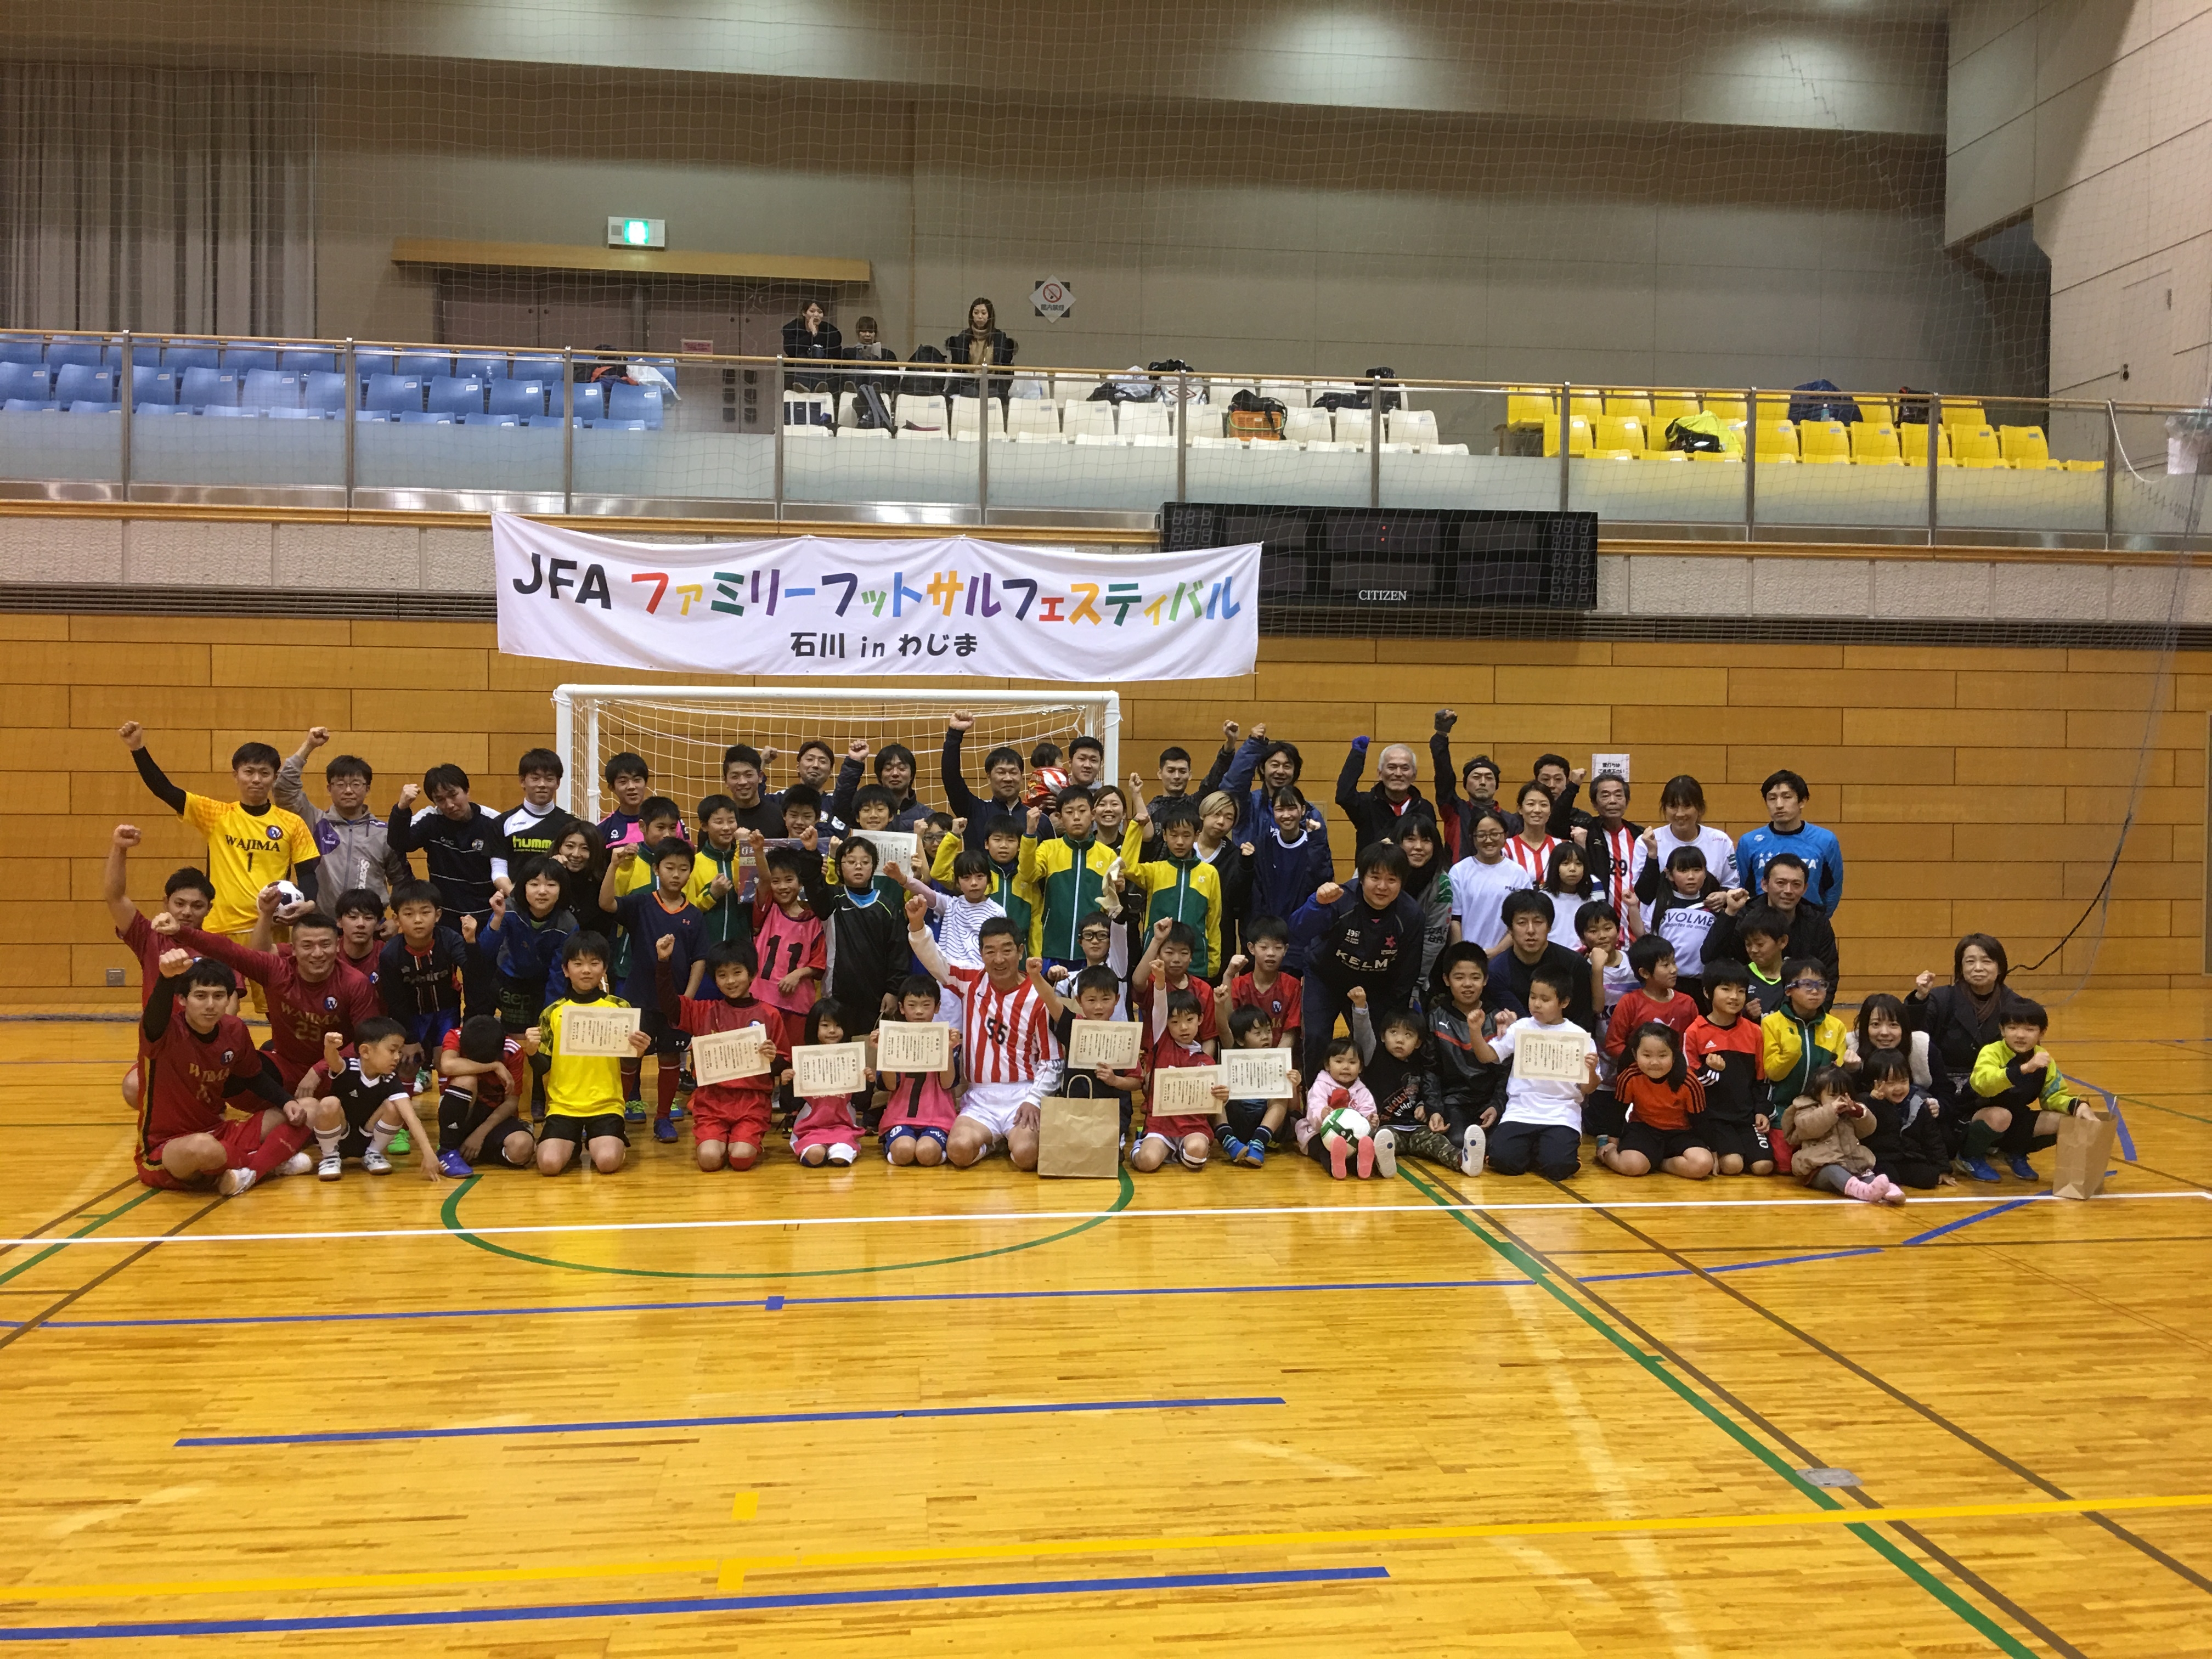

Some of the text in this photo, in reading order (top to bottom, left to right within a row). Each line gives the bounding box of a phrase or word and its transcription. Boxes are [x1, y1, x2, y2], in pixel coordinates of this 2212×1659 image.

[512, 553, 1241, 627] JFA ファミリーフットサルフェスティバル
[1358, 590, 1407, 601] CITIZEN
[790, 632, 978, 658] 石川 in わじま
[225, 834, 281, 852] WAJIMA
[247, 853, 253, 872] 1
[760, 934, 804, 981] 11
[295, 1021, 321, 1042] 23
[987, 1017, 1008, 1045] 55
[905, 1072, 927, 1118] 7
